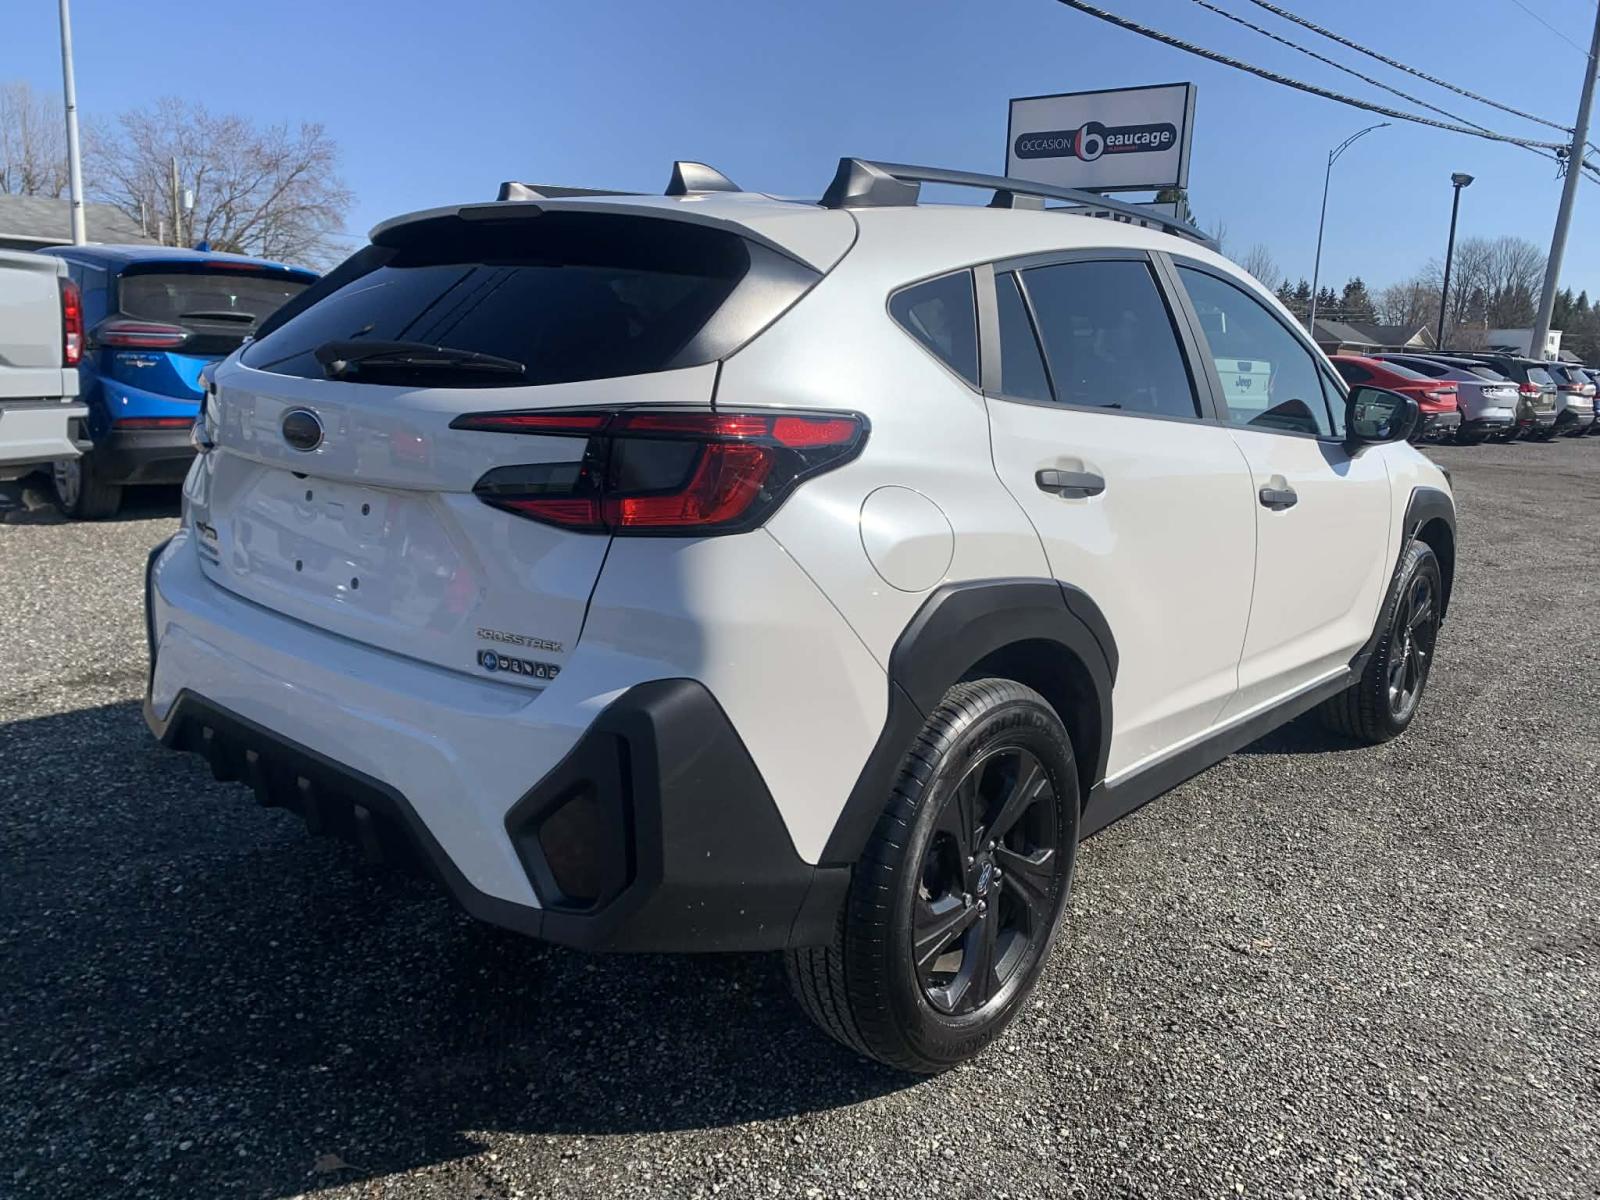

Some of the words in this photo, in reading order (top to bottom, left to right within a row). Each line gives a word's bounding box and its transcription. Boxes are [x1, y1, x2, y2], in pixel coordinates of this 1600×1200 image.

[1021, 138, 1071, 151] OCCASION
[1235, 375, 1252, 390] Jeep
[476, 627, 564, 652] CROSSTREK
